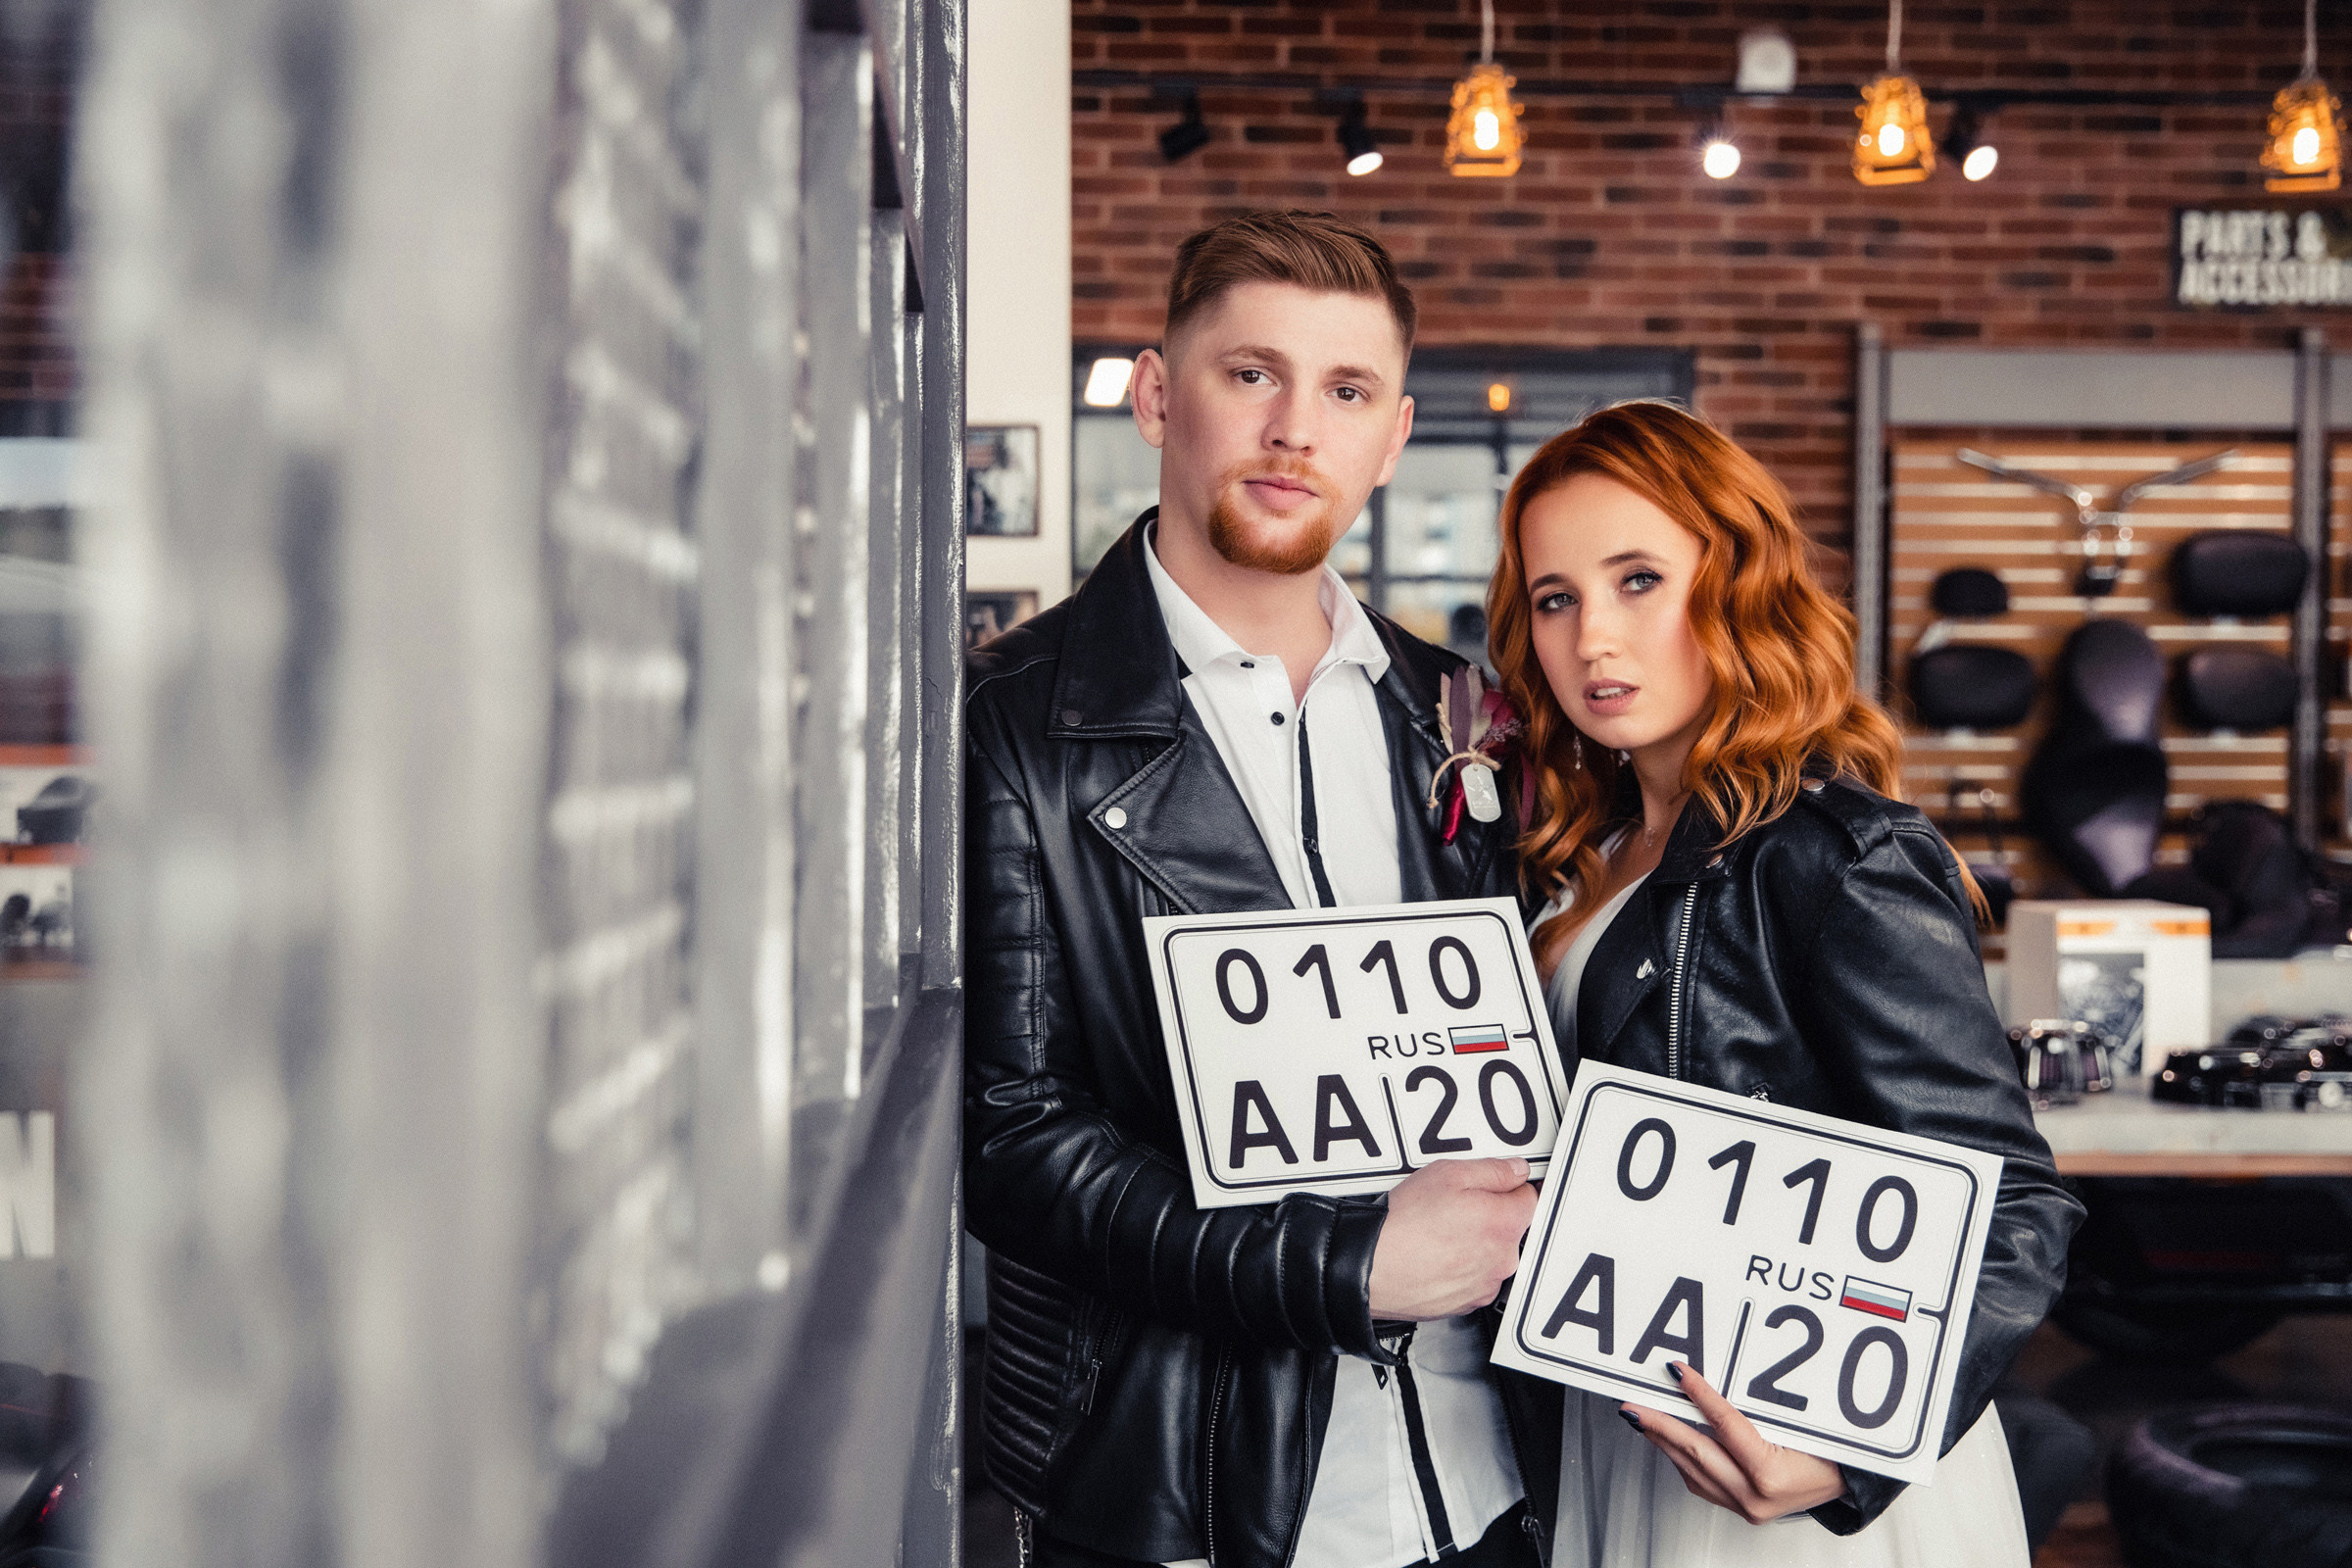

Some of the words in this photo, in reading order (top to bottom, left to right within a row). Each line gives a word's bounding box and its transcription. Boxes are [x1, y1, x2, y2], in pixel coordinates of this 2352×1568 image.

[2181, 210, 2290, 259] PARTS
[2296, 210, 2328, 259] &
[1214, 935, 1482, 1025] 0110
[1366, 1031, 1446, 1060] RUS
[1229, 1064, 1383, 1169] AA
[1403, 1058, 1540, 1155] 20
[1616, 1116, 1918, 1264] 0110
[1744, 1253, 1836, 1301] RUS
[1540, 1251, 1705, 1379] AA
[1745, 1303, 1909, 1431] 20
